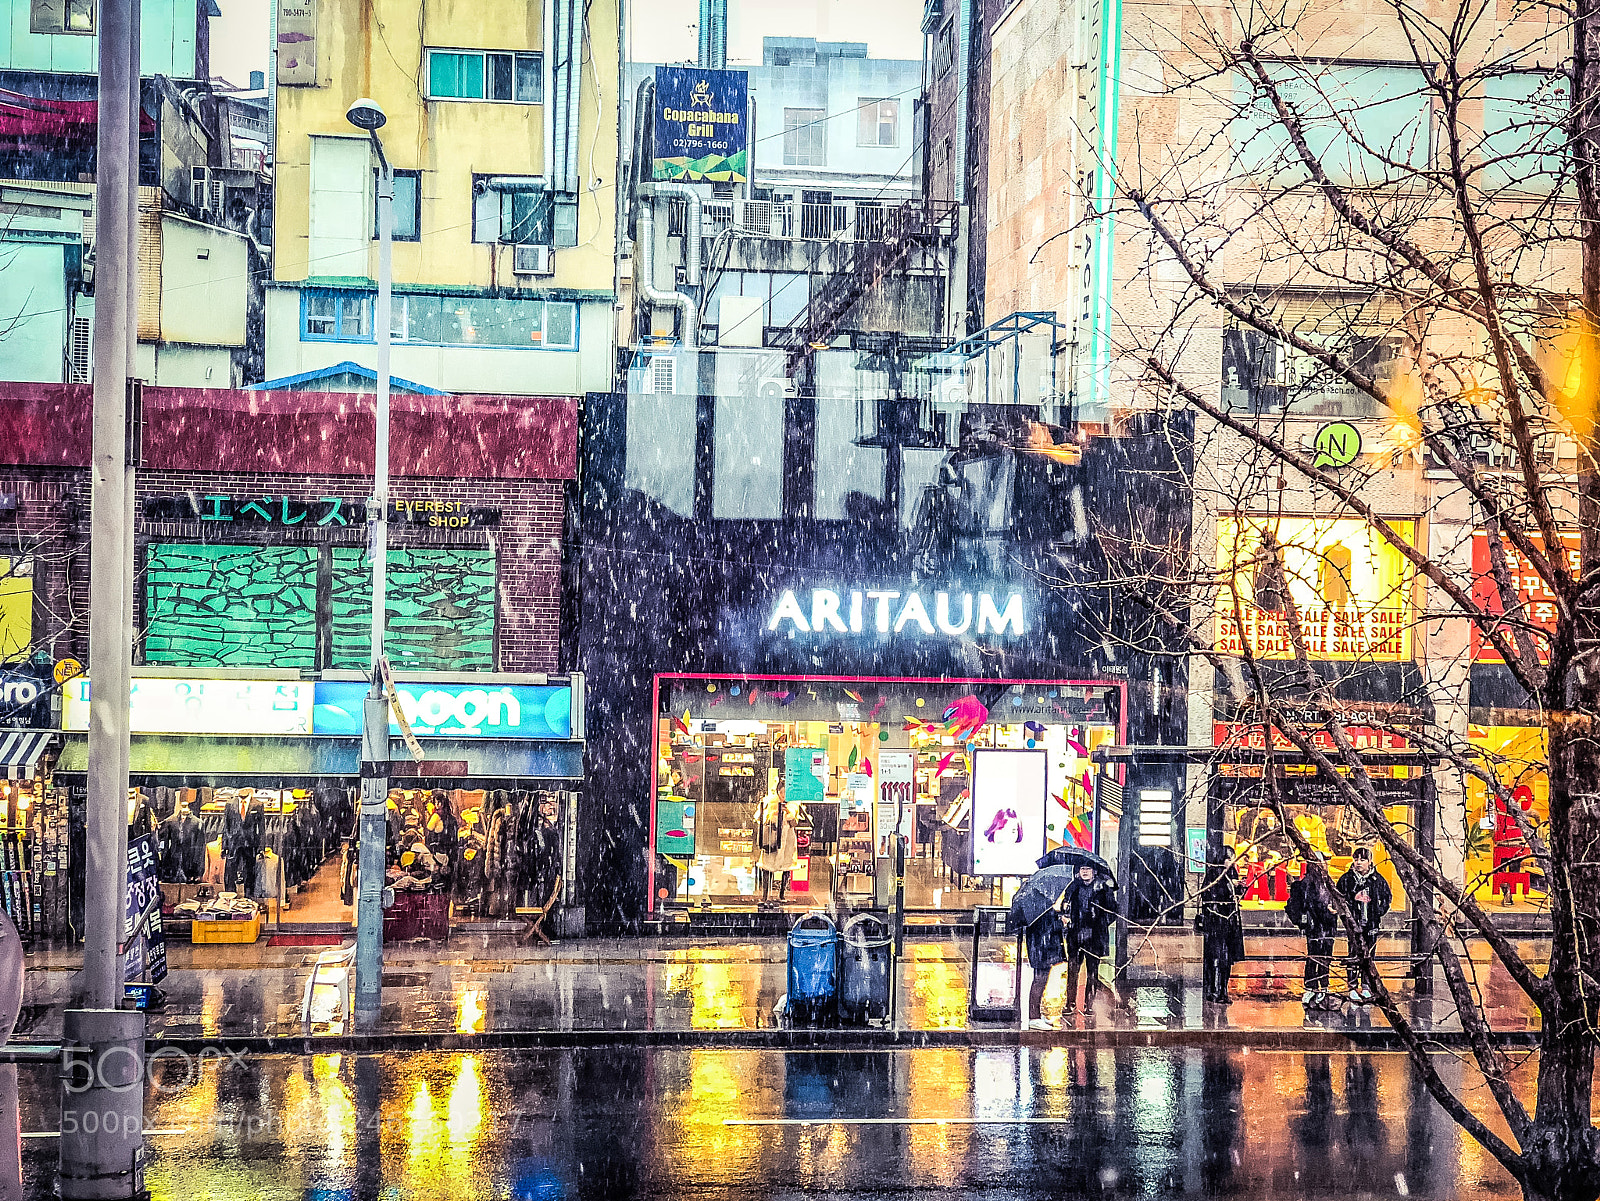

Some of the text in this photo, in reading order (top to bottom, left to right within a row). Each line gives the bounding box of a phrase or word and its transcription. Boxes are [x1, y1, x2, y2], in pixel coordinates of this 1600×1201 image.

[663, 106, 739, 124] Copacabana
[688, 123, 714, 138] Grill
[673, 138, 728, 149] 02)796-1660
[1329, 433, 1347, 457] N
[395, 500, 463, 513] EVEREST
[428, 515, 469, 528] SHOP
[768, 589, 1025, 636] ARITAUM
[1296, 611, 1328, 622] SALE
[1334, 612, 1365, 623] SALE
[1371, 612, 1404, 624] SALE
[1220, 624, 1252, 636] SAE
[1333, 627, 1365, 638] SALE
[1371, 627, 1403, 639] SALE
[1257, 640, 1290, 652] SALE
[1333, 641, 1365, 653] SALE
[1371, 642, 1403, 654] SALE
